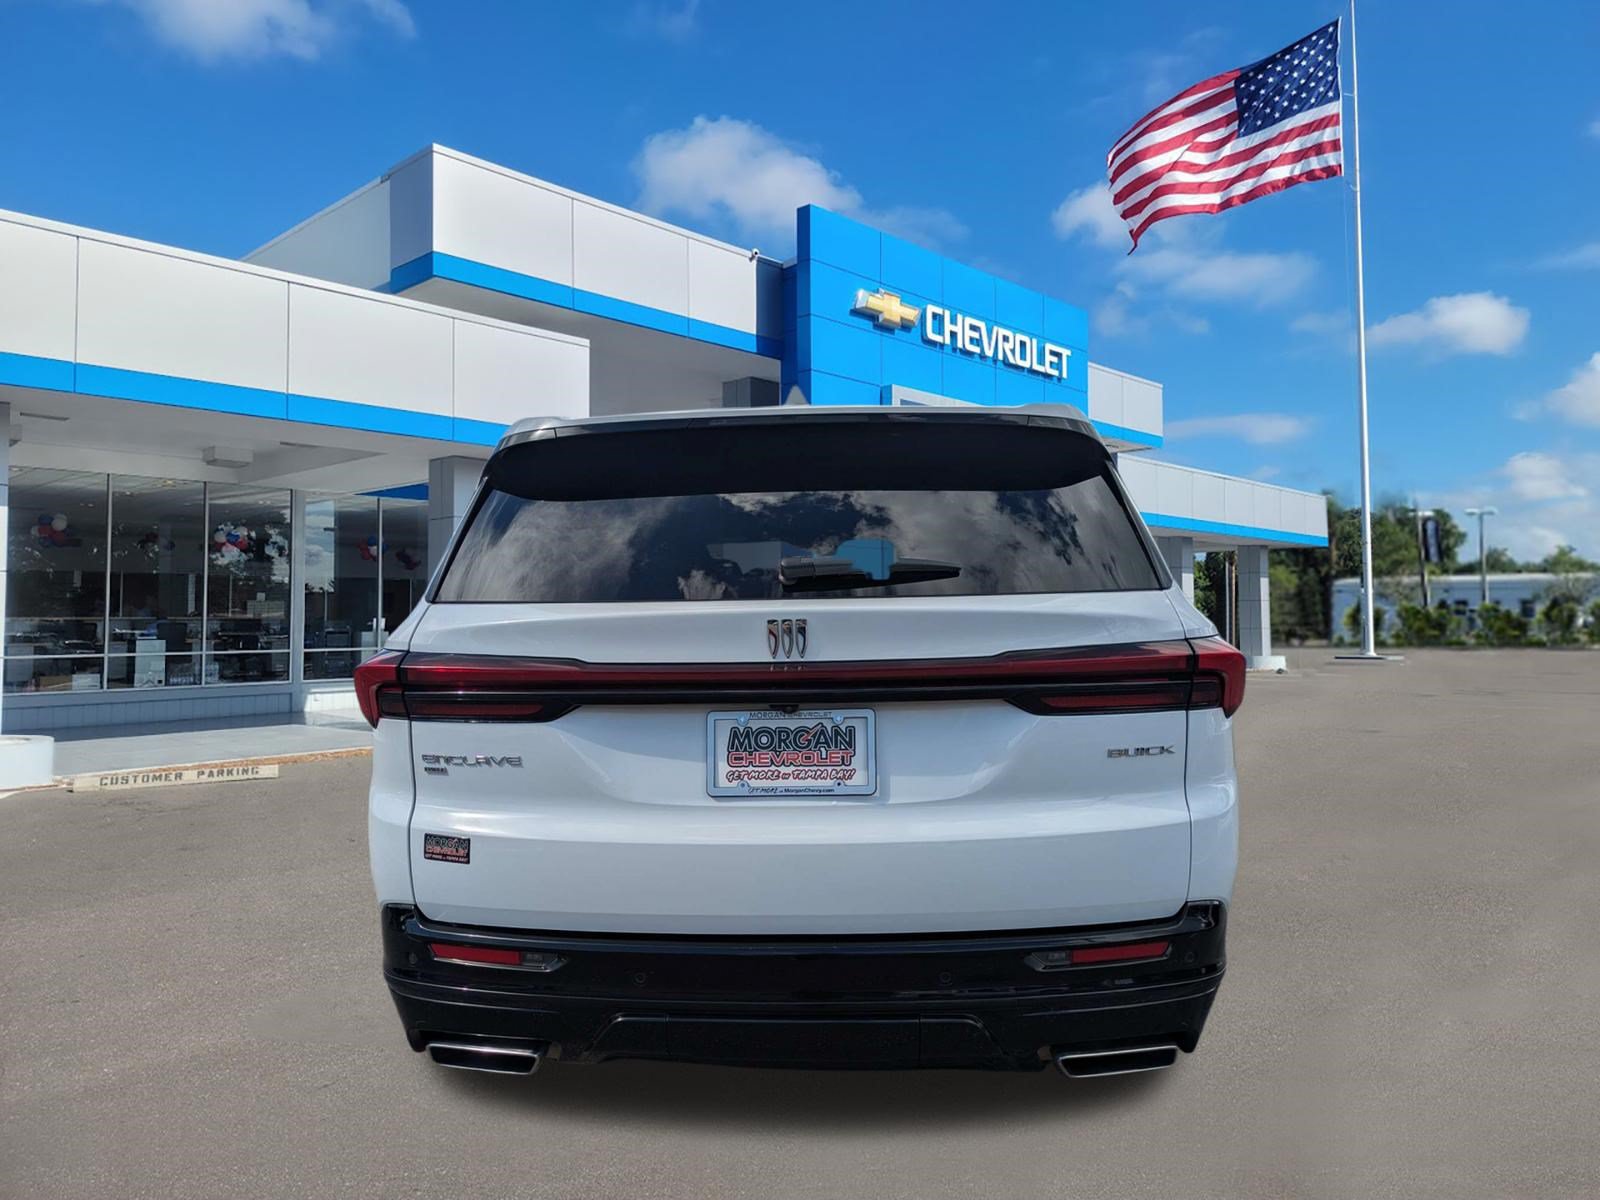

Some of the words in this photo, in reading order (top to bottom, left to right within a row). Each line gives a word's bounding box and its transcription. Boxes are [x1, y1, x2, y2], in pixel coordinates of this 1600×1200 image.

[924, 303, 1072, 379] CHEVROLET
[728, 723, 856, 751] MORGAN
[728, 750, 854, 767] CHEVROLET
[1107, 745, 1176, 759] BUICK
[421, 754, 523, 768] ENCLAVE
[100, 772, 184, 786] CUSTOMER
[196, 766, 260, 779] PARKING
[726, 770, 749, 783] GET
[748, 769, 781, 780] MORE
[792, 769, 829, 780] TAMPA
[829, 768, 857, 781] BAY!
